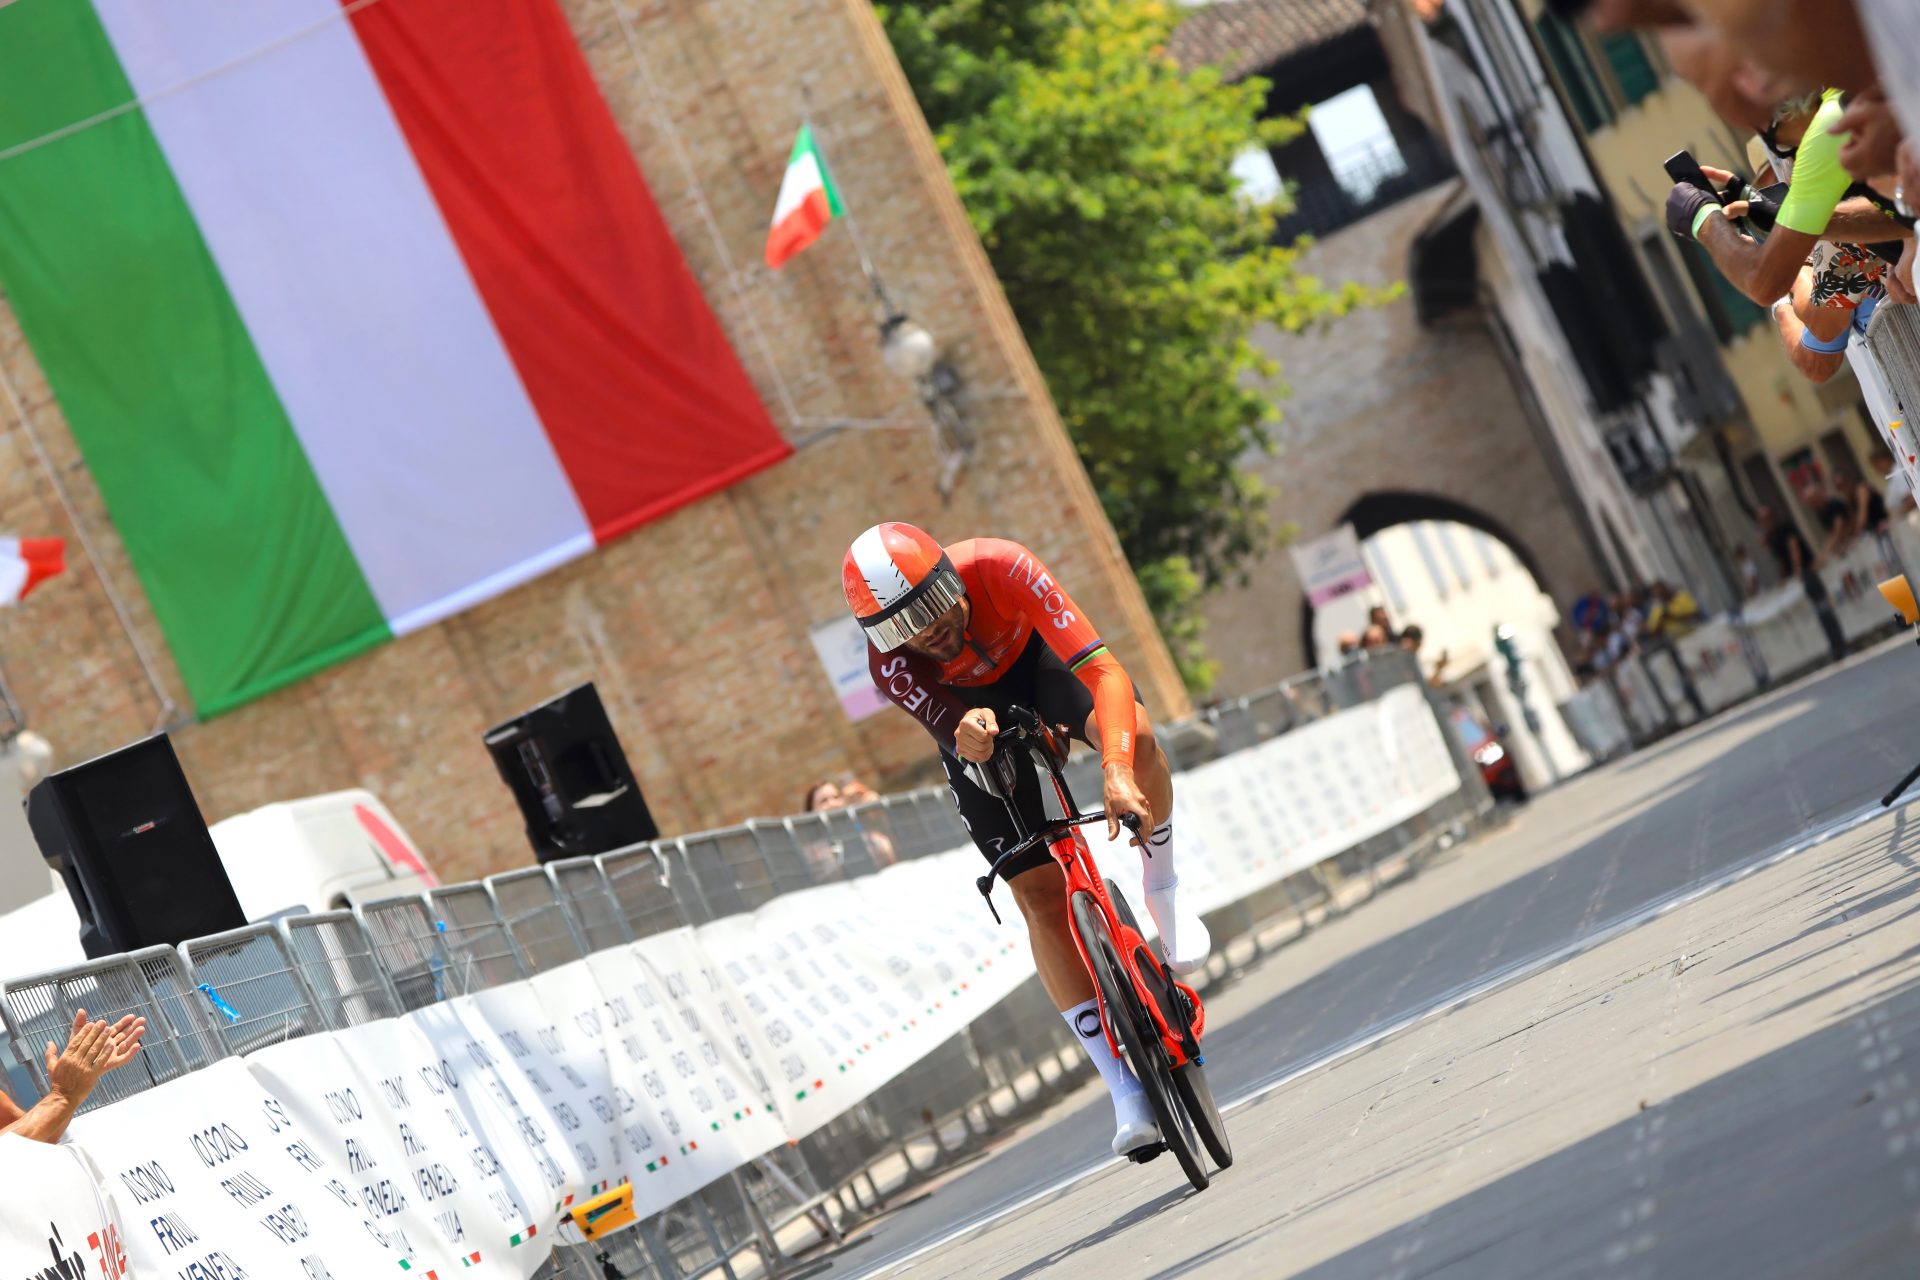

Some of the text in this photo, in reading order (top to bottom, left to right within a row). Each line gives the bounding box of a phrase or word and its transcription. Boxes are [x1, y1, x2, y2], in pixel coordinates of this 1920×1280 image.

[1008, 553, 1076, 629] INEOS
[881, 656, 947, 726] INEOS
[356, 1179, 411, 1220] VENEZIA
[412, 1163, 462, 1202] VENEZIA
